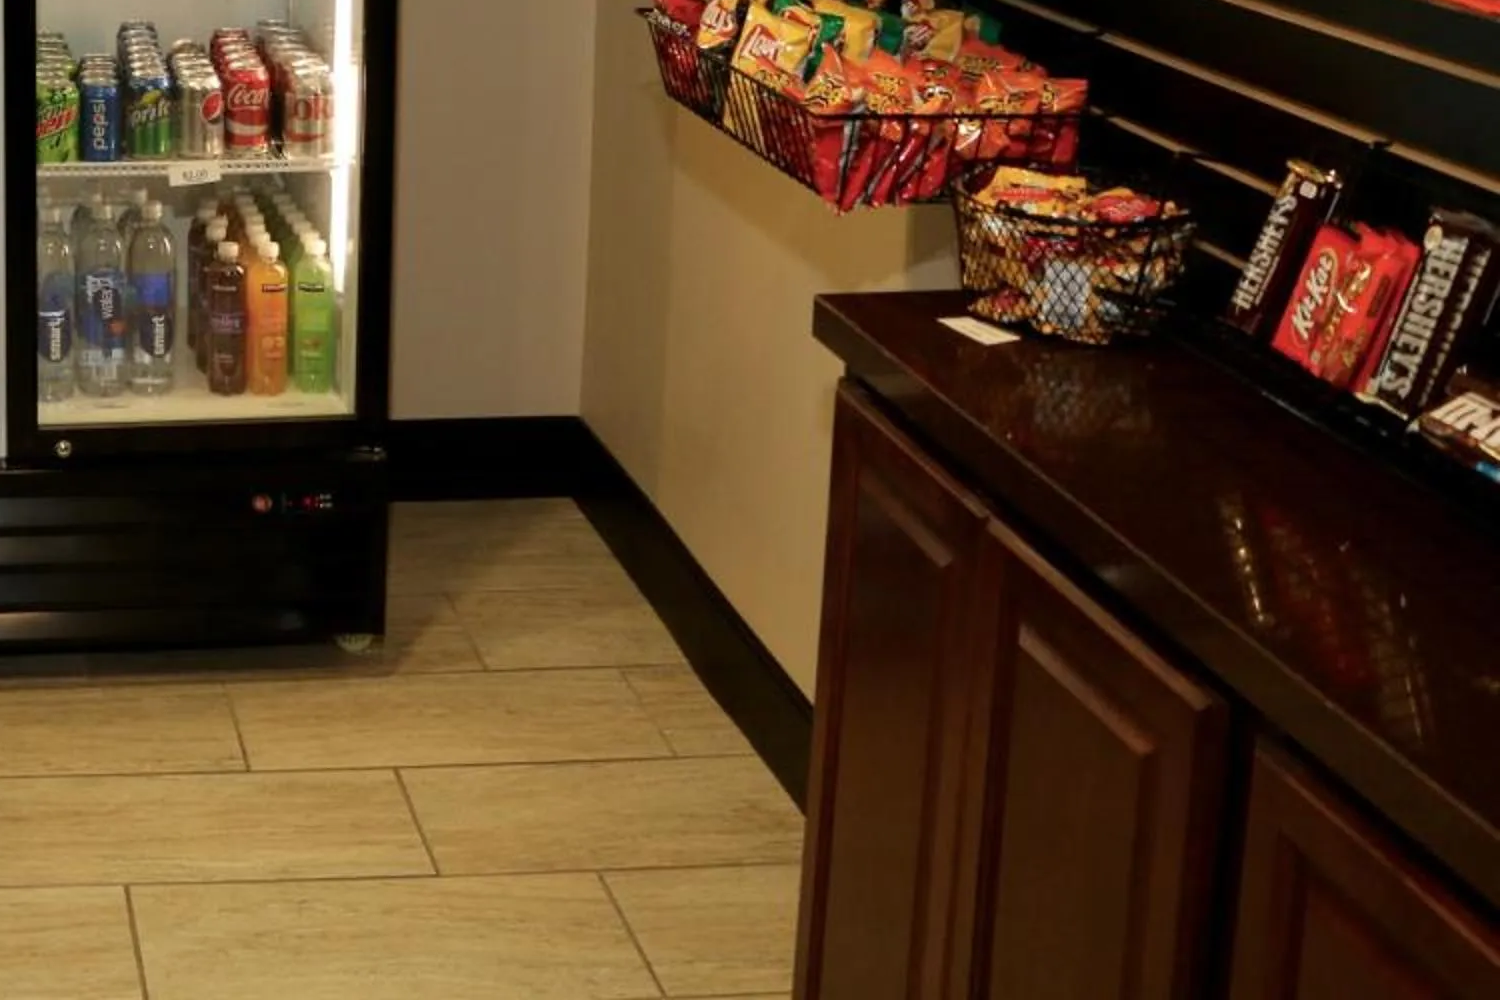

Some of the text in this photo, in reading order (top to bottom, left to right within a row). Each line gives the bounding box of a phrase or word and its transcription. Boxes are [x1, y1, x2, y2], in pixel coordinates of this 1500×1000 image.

[92, 99, 108, 151] pepsi
[48, 317, 64, 361] smart
[151, 314, 165, 355] smart
